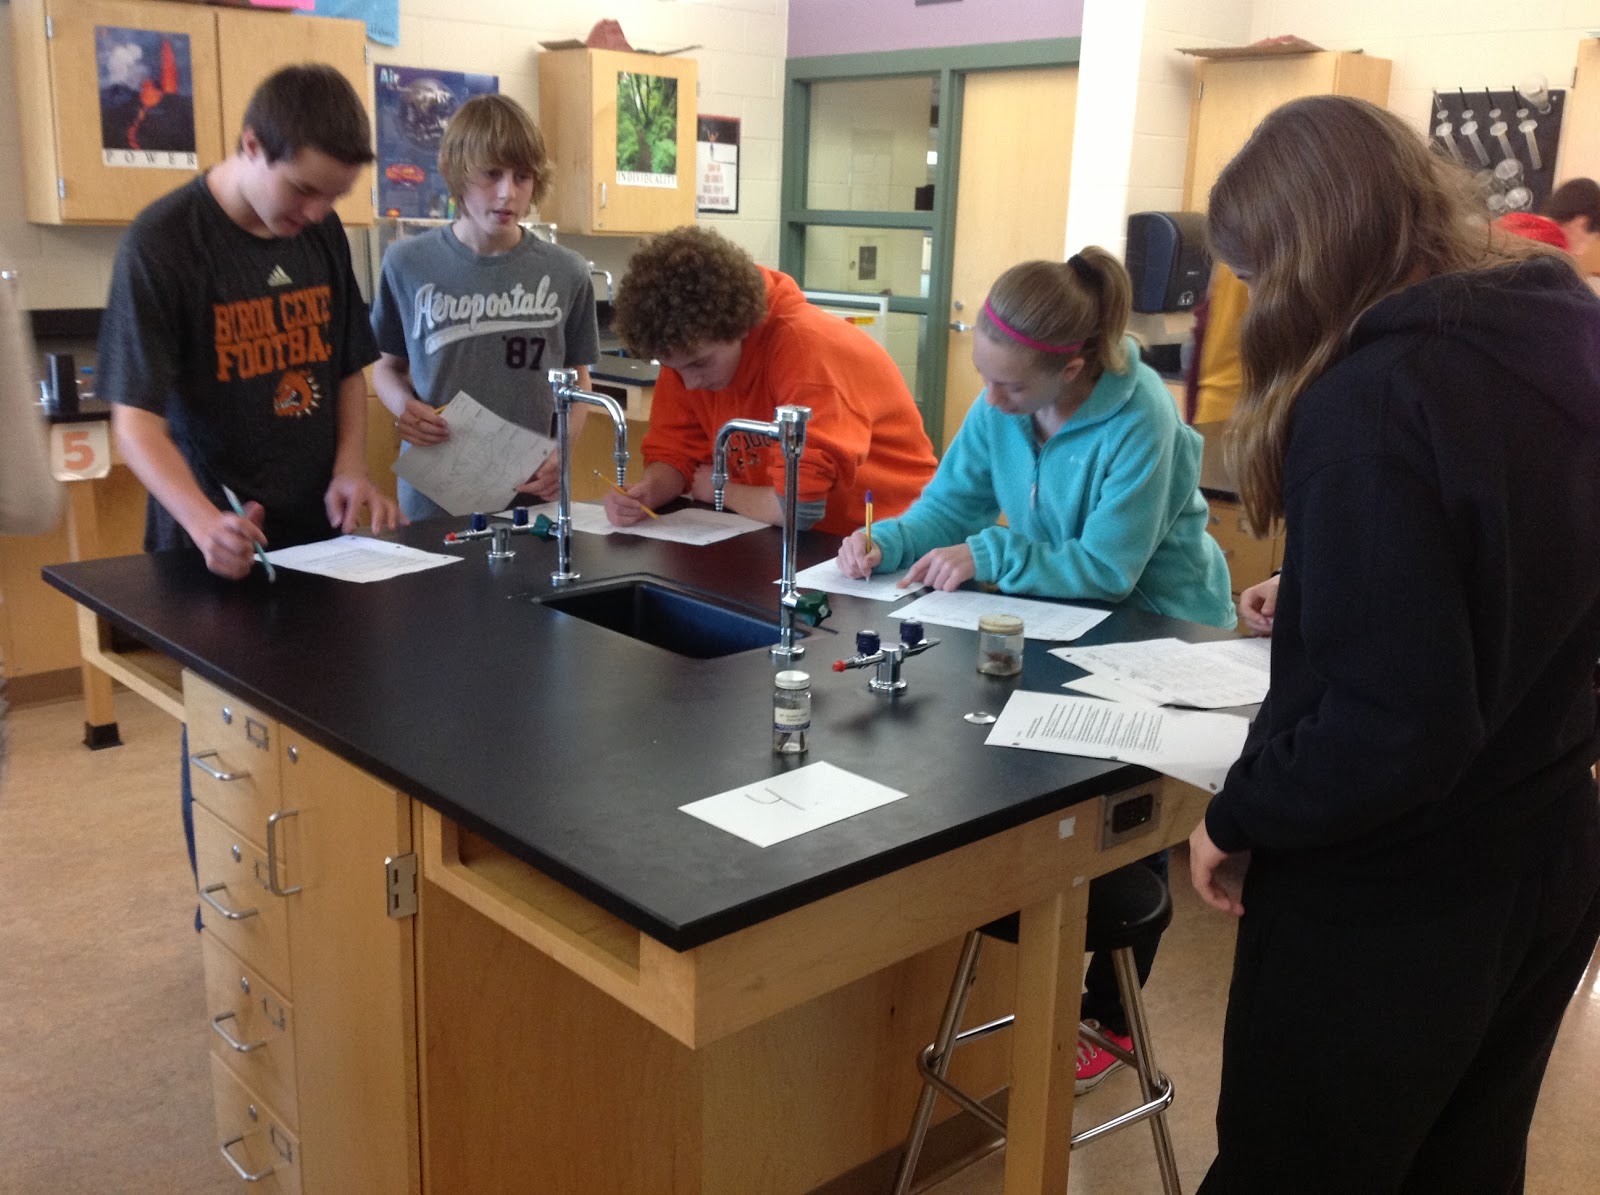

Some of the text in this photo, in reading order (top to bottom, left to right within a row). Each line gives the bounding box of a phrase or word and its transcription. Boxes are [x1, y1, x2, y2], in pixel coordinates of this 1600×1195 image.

[106, 149, 195, 166] POWER
[216, 325, 333, 382] FOOTBA
[63, 431, 94, 470] 5
